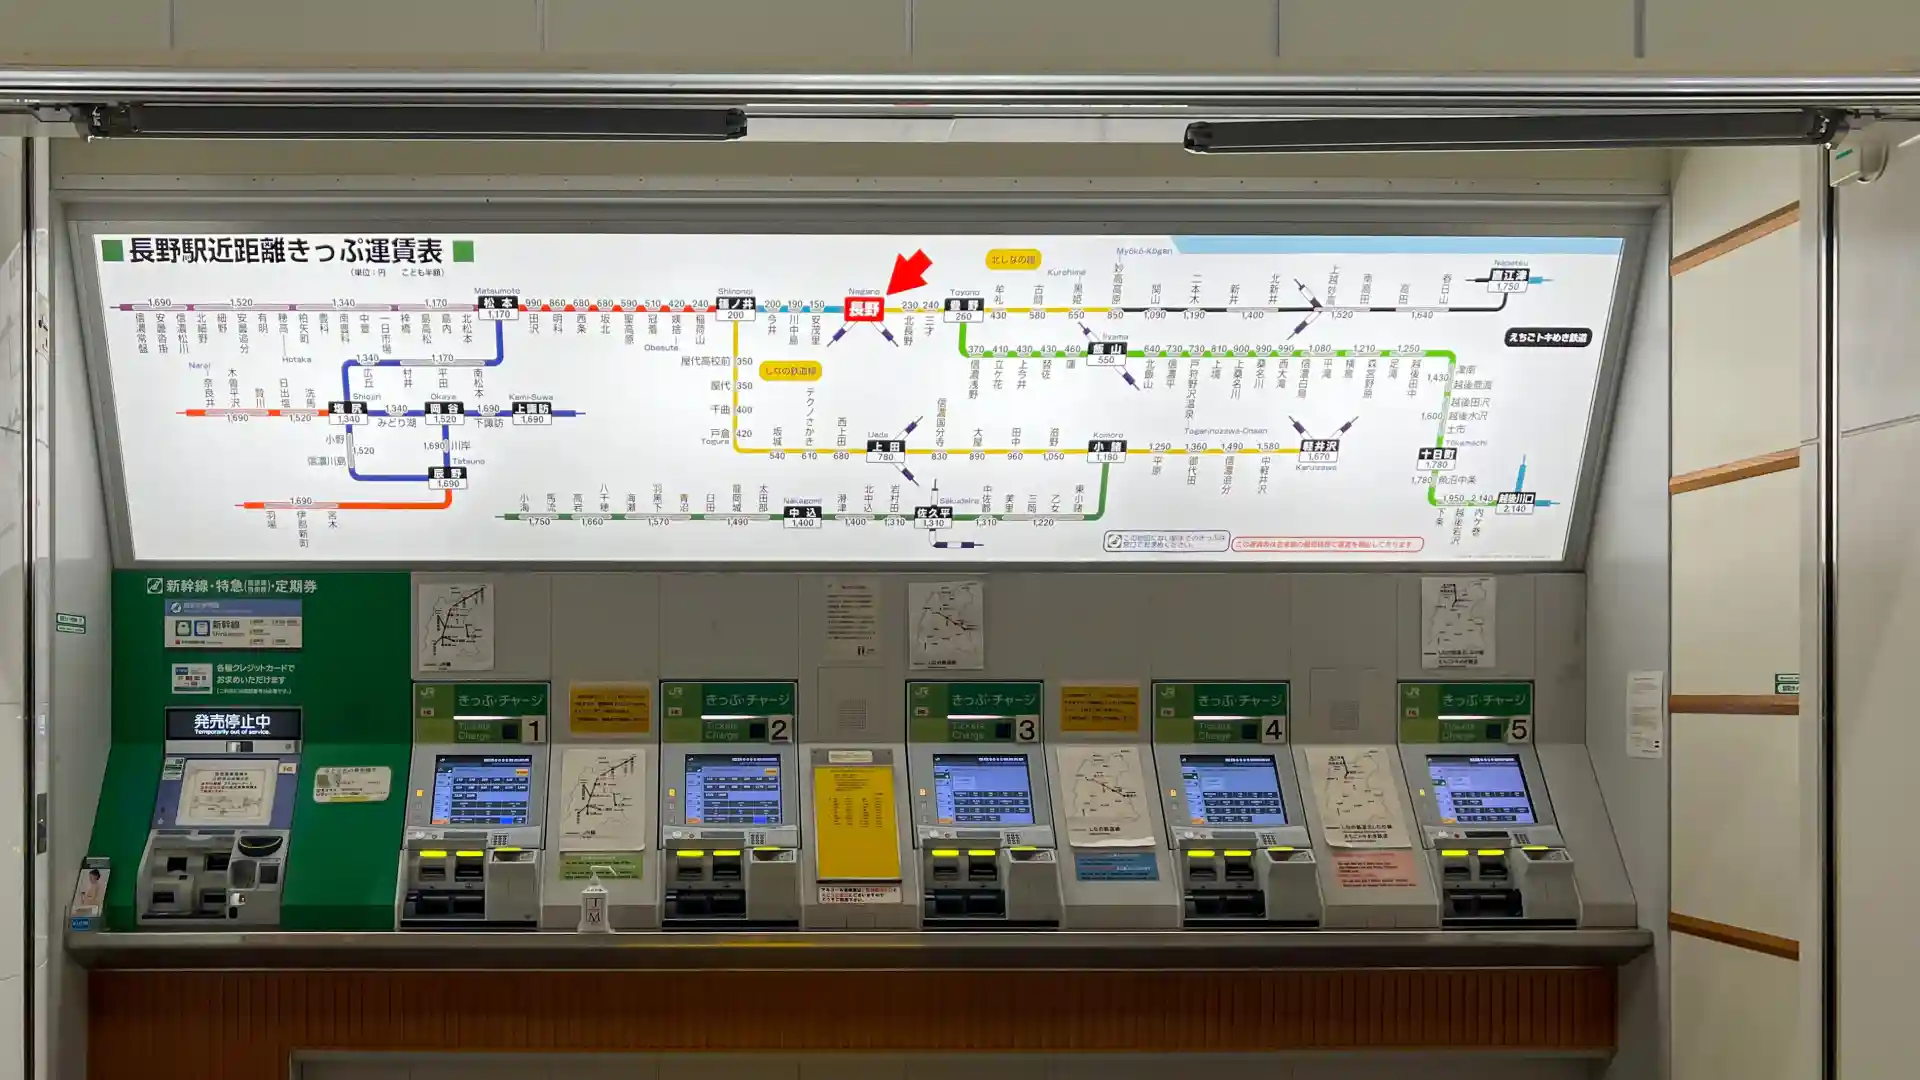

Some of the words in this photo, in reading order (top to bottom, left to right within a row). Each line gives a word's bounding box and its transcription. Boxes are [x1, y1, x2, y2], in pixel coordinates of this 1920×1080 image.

[129, 237, 443, 264] 長野駅近距離きっぷ運賃表
[474, 287, 521, 295] Matsumoto
[950, 289, 980, 297] Toyono
[1190, 274, 1202, 304] 二本木
[1268, 273, 1280, 304] 北新井
[1229, 284, 1240, 304] 新井
[148, 298, 171, 307] 1,690
[230, 298, 253, 307] 1,520
[332, 299, 355, 307] 1,340
[425, 299, 448, 307] 1,170
[484, 297, 513, 309] 松本
[525, 299, 542, 307] 990
[549, 299, 566, 307] 860
[573, 299, 590, 307] 680
[597, 299, 614, 307] 680
[621, 299, 638, 307] 590
[645, 299, 662, 307] 510
[668, 299, 685, 307] 420
[692, 299, 709, 307] 240
[765, 300, 781, 308] 200
[788, 300, 803, 308] 190
[809, 300, 825, 308] 150
[902, 301, 918, 309] 230
[922, 301, 939, 309] 240
[488, 310, 511, 318] 1,170
[848, 301, 880, 318] 長野
[727, 311, 744, 319] 200
[955, 312, 973, 320] 260
[1183, 311, 1205, 320] 1,190
[1241, 311, 1264, 320] 1,400
[1411, 311, 1434, 320] 1,640
[258, 313, 268, 333] 有明
[441, 314, 452, 334] 島内
[529, 314, 540, 334] 田沢
[553, 314, 562, 334] 明科
[577, 314, 587, 334] 西条
[600, 314, 610, 334] 坂北
[767, 315, 777, 335] 今井
[924, 317, 935, 337] 三才
[462, 314, 472, 344] 北松本
[695, 315, 705, 345] 稲荷山
[789, 315, 799, 345] 川中島
[811, 315, 821, 345] 安茂里
[903, 316, 914, 346] 北長野
[380, 316, 392, 354] 一日市場
[1508, 332, 1588, 344] えちごトキめき鉄道
[1211, 344, 1227, 353] 810
[1233, 344, 1250, 353] 900
[1397, 344, 1420, 353] 1,250
[282, 356, 312, 364] Hotaka
[681, 356, 731, 367] 屋代高校前
[737, 357, 753, 365] 350
[1098, 355, 1115, 364] 550
[364, 368, 374, 388] 広丘
[403, 369, 413, 388] 村井
[438, 369, 448, 388] 平田
[1017, 360, 1027, 389] 上今井
[1254, 359, 1266, 389] 桑名川
[1427, 373, 1449, 382] 1,430
[473, 369, 484, 398] 南松本
[711, 380, 731, 391] 屋代
[737, 381, 753, 389] 350
[509, 393, 554, 401] Kami-Suwa
[711, 405, 731, 415] 千曲
[736, 405, 753, 414] 400
[227, 414, 249, 422] 1,690
[289, 414, 311, 422] 1,520
[338, 415, 360, 423] 1,340
[434, 415, 457, 423] 1,520
[520, 415, 544, 423] 1,690
[805, 387, 815, 447] テクノさかき
[1448, 411, 1489, 421] 越後水沢
[377, 418, 416, 428] みどり湖
[736, 429, 752, 438] 420
[837, 417, 847, 447] 西上田
[1447, 425, 1466, 434] 土市
[326, 434, 345, 445] 小野
[773, 427, 783, 447] 坂城
[973, 428, 983, 447] 大屋
[1011, 428, 1021, 447] 田中
[1093, 431, 1124, 439] Komoro
[423, 441, 445, 450] 1,690
[452, 440, 471, 451] 川岸
[872, 441, 900, 453] 上田
[1149, 442, 1171, 450] 1,250
[353, 446, 375, 455] 1,520
[1420, 449, 1456, 460] 十日町
[769, 452, 786, 460] 540
[801, 452, 818, 460] 610
[833, 452, 850, 460] 680
[878, 453, 894, 461] 780
[931, 452, 948, 460] 830
[969, 452, 986, 460] 890
[1007, 452, 1024, 460] 960
[1042, 452, 1065, 460] 1,050
[1308, 452, 1331, 460] 1,670
[1425, 461, 1448, 469] 1,780
[290, 497, 312, 505] 1,690
[520, 493, 530, 512] 小海
[759, 484, 768, 512] 太田部
[864, 484, 874, 512] 北中込
[889, 484, 900, 513] 岩村田
[1051, 494, 1061, 513] 乙女
[1503, 504, 1527, 512] 2,140
[789, 507, 818, 518] 中込
[917, 507, 951, 518] 佐久平
[528, 518, 550, 526] 1,750
[581, 518, 603, 526] 1,660
[648, 518, 670, 526] 1,570
[727, 518, 749, 526] 1,490
[792, 518, 815, 526] 1,400
[844, 518, 866, 526] 1,400
[884, 518, 906, 526] 1,310
[975, 518, 997, 526] 1,310
[1032, 518, 1054, 526] 1,220
[216, 675, 286, 685] お求めいただけます
[421, 687, 436, 697] JR
[668, 687, 683, 697] JR
[914, 687, 929, 697] JR
[1161, 687, 1176, 697] JR
[1406, 687, 1421, 697] JR
[458, 693, 544, 707] きっぷ・チャージ
[706, 693, 790, 707] きっぷ・チャージ
[952, 693, 1036, 707] きっぷ・チャージ
[1198, 693, 1283, 707] きっぷ・チャージ
[1443, 693, 1526, 707] きっぷ・チャージ
[194, 713, 271, 730] 発売停止中
[194, 728, 229, 736] Temporarily
[230, 728, 241, 736] out
[241, 728, 248, 736] of
[248, 728, 271, 736] service.
[528, 719, 539, 741] 1
[771, 719, 788, 741] 2
[1019, 719, 1036, 741] 3
[1265, 719, 1282, 741] 4
[1511, 719, 1528, 741] 5
